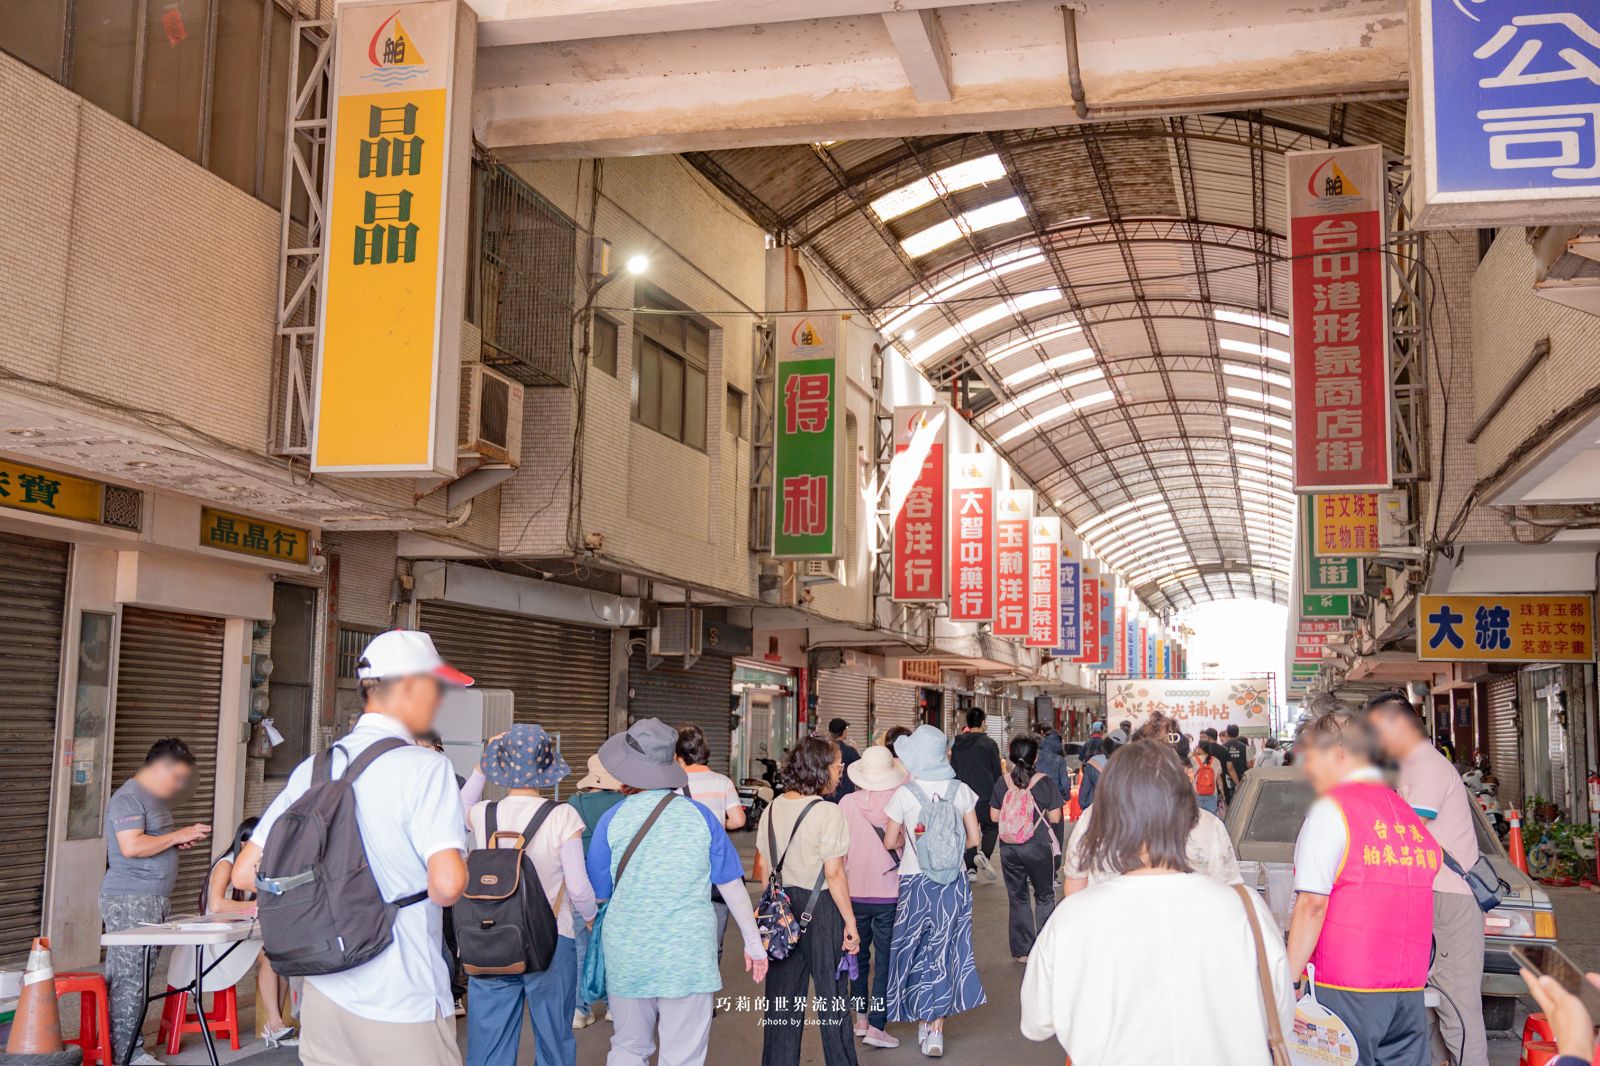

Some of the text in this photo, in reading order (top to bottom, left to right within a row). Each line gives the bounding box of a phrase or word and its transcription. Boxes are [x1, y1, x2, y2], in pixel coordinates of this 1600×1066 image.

[1473, 13, 1600, 178] 公司
[353, 102, 424, 265] 晶晶
[1312, 219, 1363, 471] 台中港形象商店街
[783, 373, 829, 536] 得利
[210, 515, 298, 557] 晶晶行
[904, 450, 933, 592] 容洋行
[960, 491, 984, 615] 大智中藥行
[1428, 605, 1511, 649] 大統
[1520, 603, 1585, 617] 珠寶玉器
[1520, 621, 1585, 635] 古玩文物
[1373, 819, 1424, 843] 台中港
